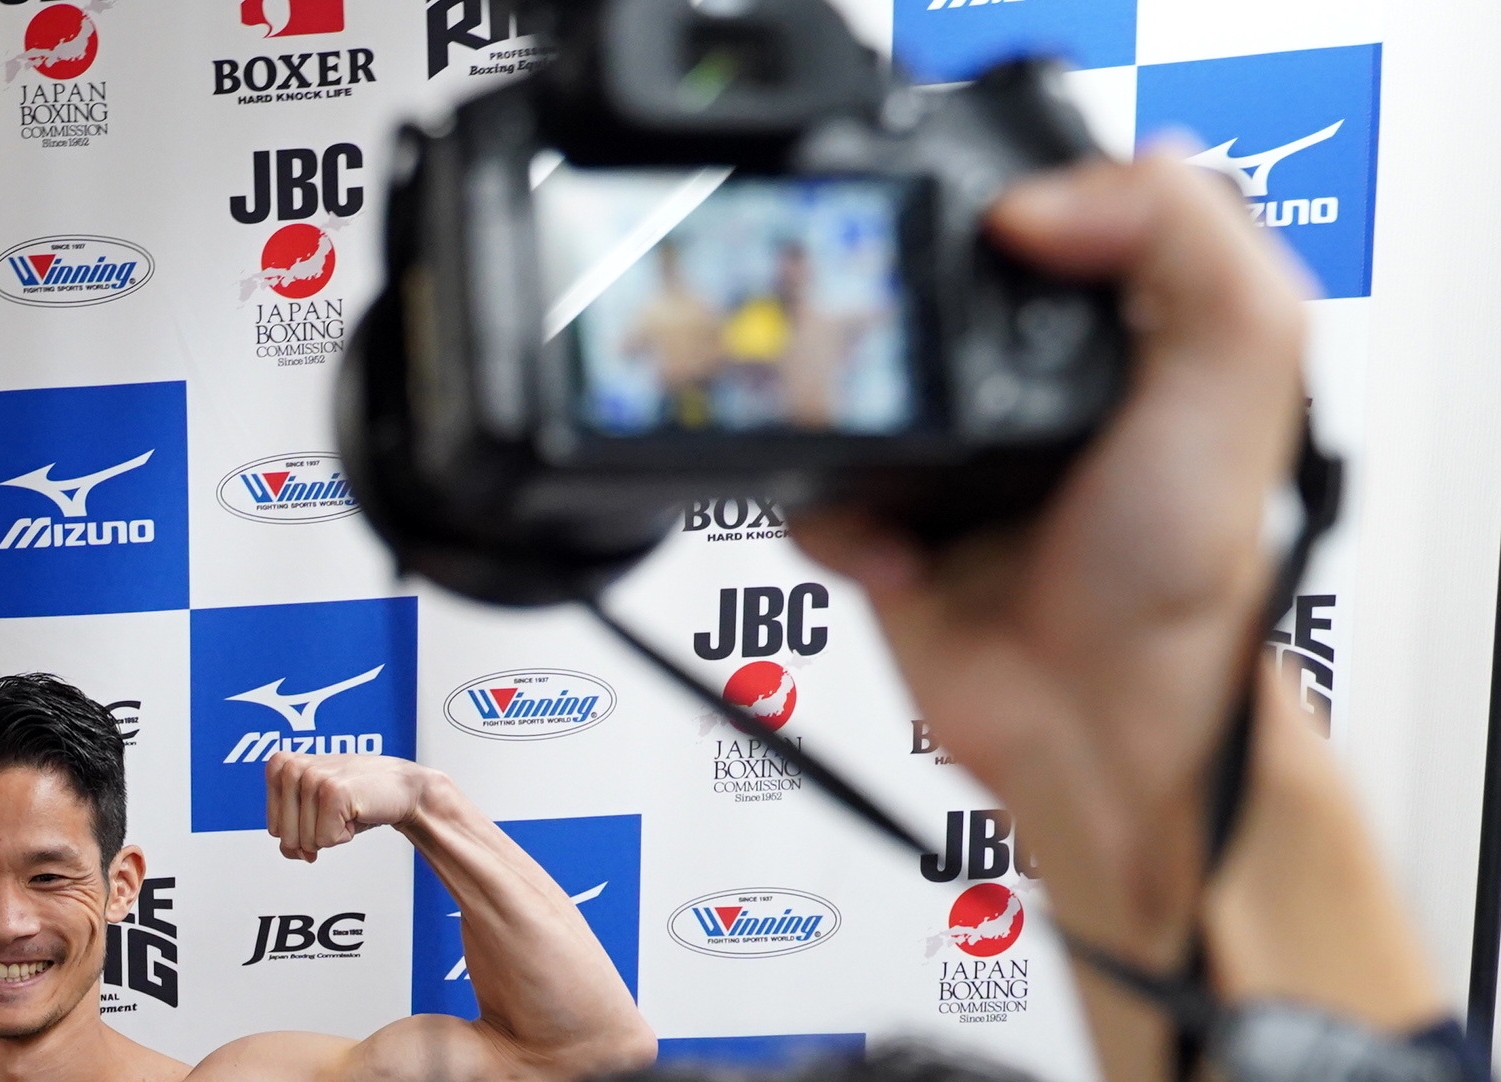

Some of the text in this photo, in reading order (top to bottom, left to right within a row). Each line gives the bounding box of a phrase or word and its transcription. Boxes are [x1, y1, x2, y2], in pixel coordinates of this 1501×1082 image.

[214, 49, 378, 95] BOXER
[468, 63, 514, 76] Boxing
[20, 81, 105, 105] JAPAN
[239, 88, 353, 105] HARD KNOCK LIFE
[21, 102, 107, 125] BOXING
[21, 123, 107, 138] COMMISSION
[231, 143, 363, 225] JBC
[6, 254, 136, 289] Winning
[256, 298, 341, 324] JAPAN
[256, 319, 343, 344] BOXING
[256, 340, 343, 357] COMMISSION
[707, 529, 790, 542] HARD KNOC
[695, 582, 829, 661] JBC
[468, 688, 598, 722] Winning
[714, 778, 801, 793] COMMISSION
[920, 809, 1041, 881] JB
[692, 906, 822, 941] Winning
[242, 913, 365, 966] JBC
[940, 959, 1027, 981] JAPAN
[940, 979, 1027, 1000] BOXING
[939, 1000, 1026, 1013] COMMISSION
